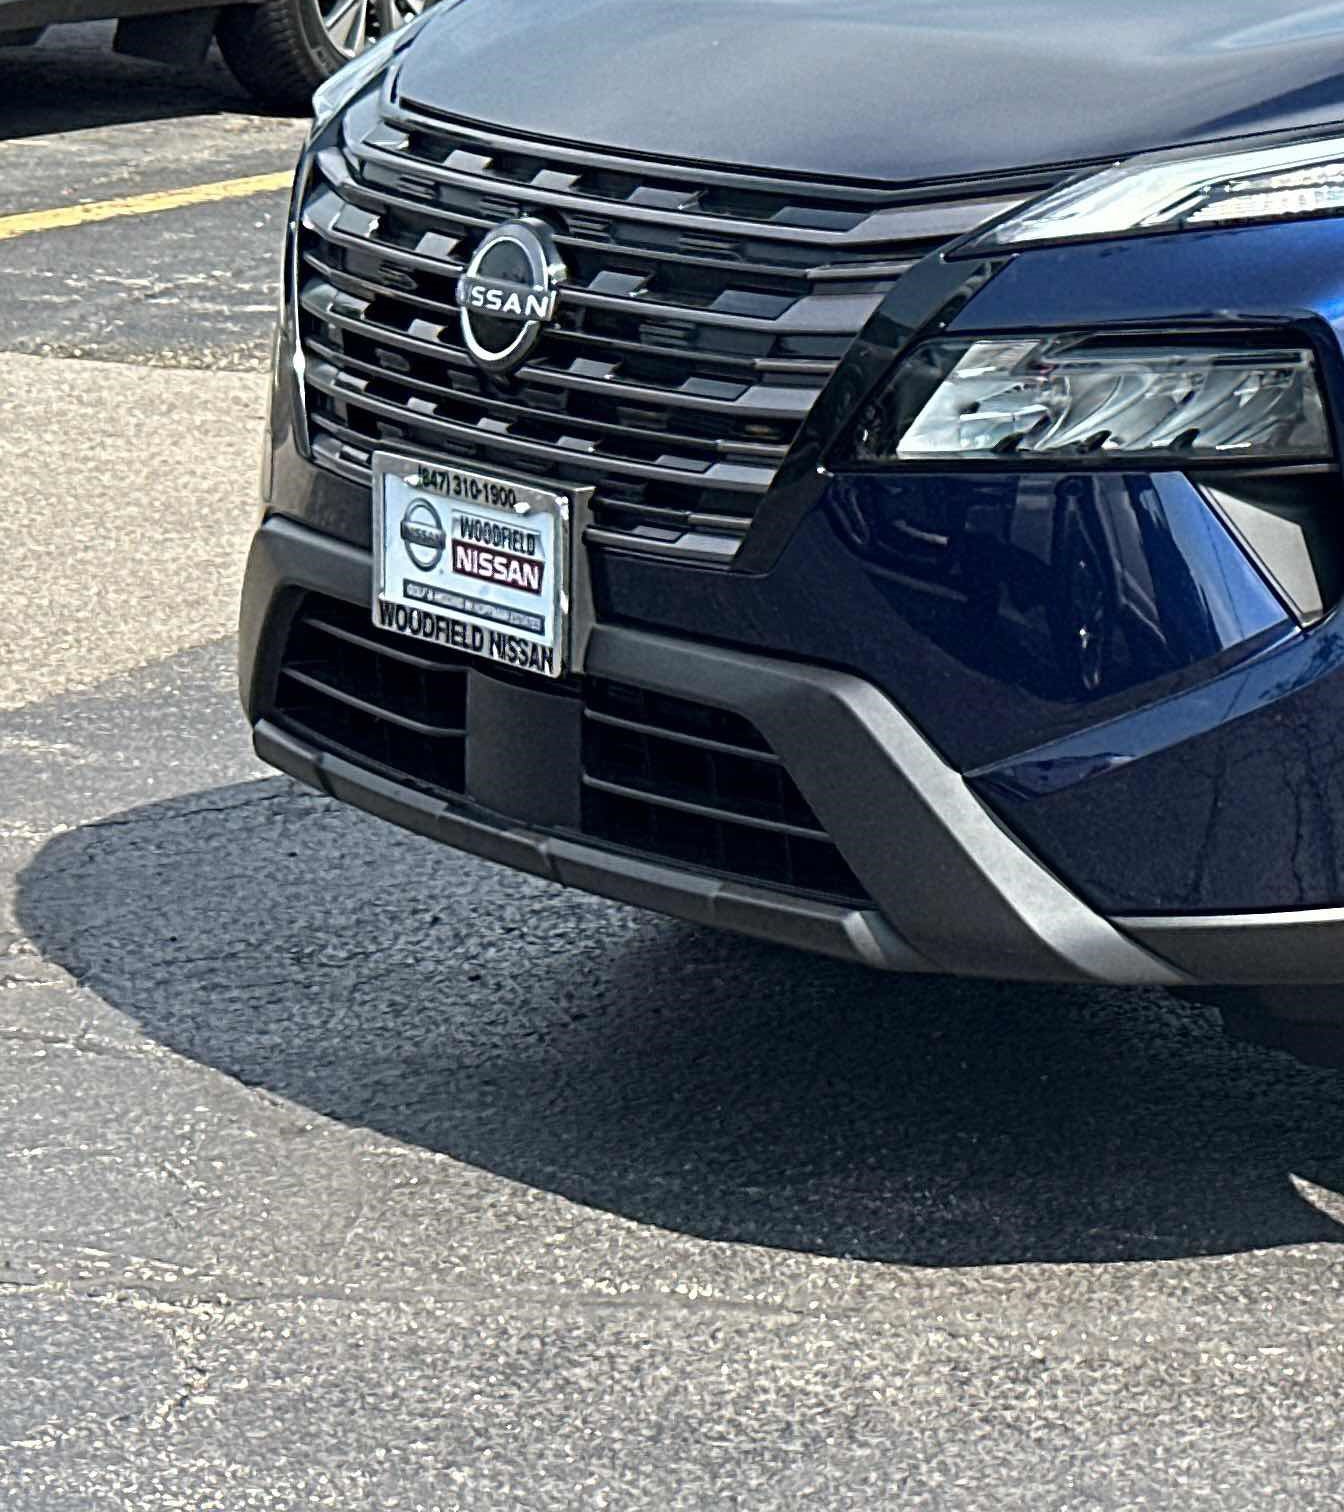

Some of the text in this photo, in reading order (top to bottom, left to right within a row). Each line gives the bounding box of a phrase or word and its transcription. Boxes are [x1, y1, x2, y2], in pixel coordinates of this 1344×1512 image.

[453, 470, 517, 509] 310-1900
[460, 515, 536, 556] WOODFIELD
[455, 546, 539, 590] NISSAN
[378, 600, 554, 673] WOODFIELD NISSAN
